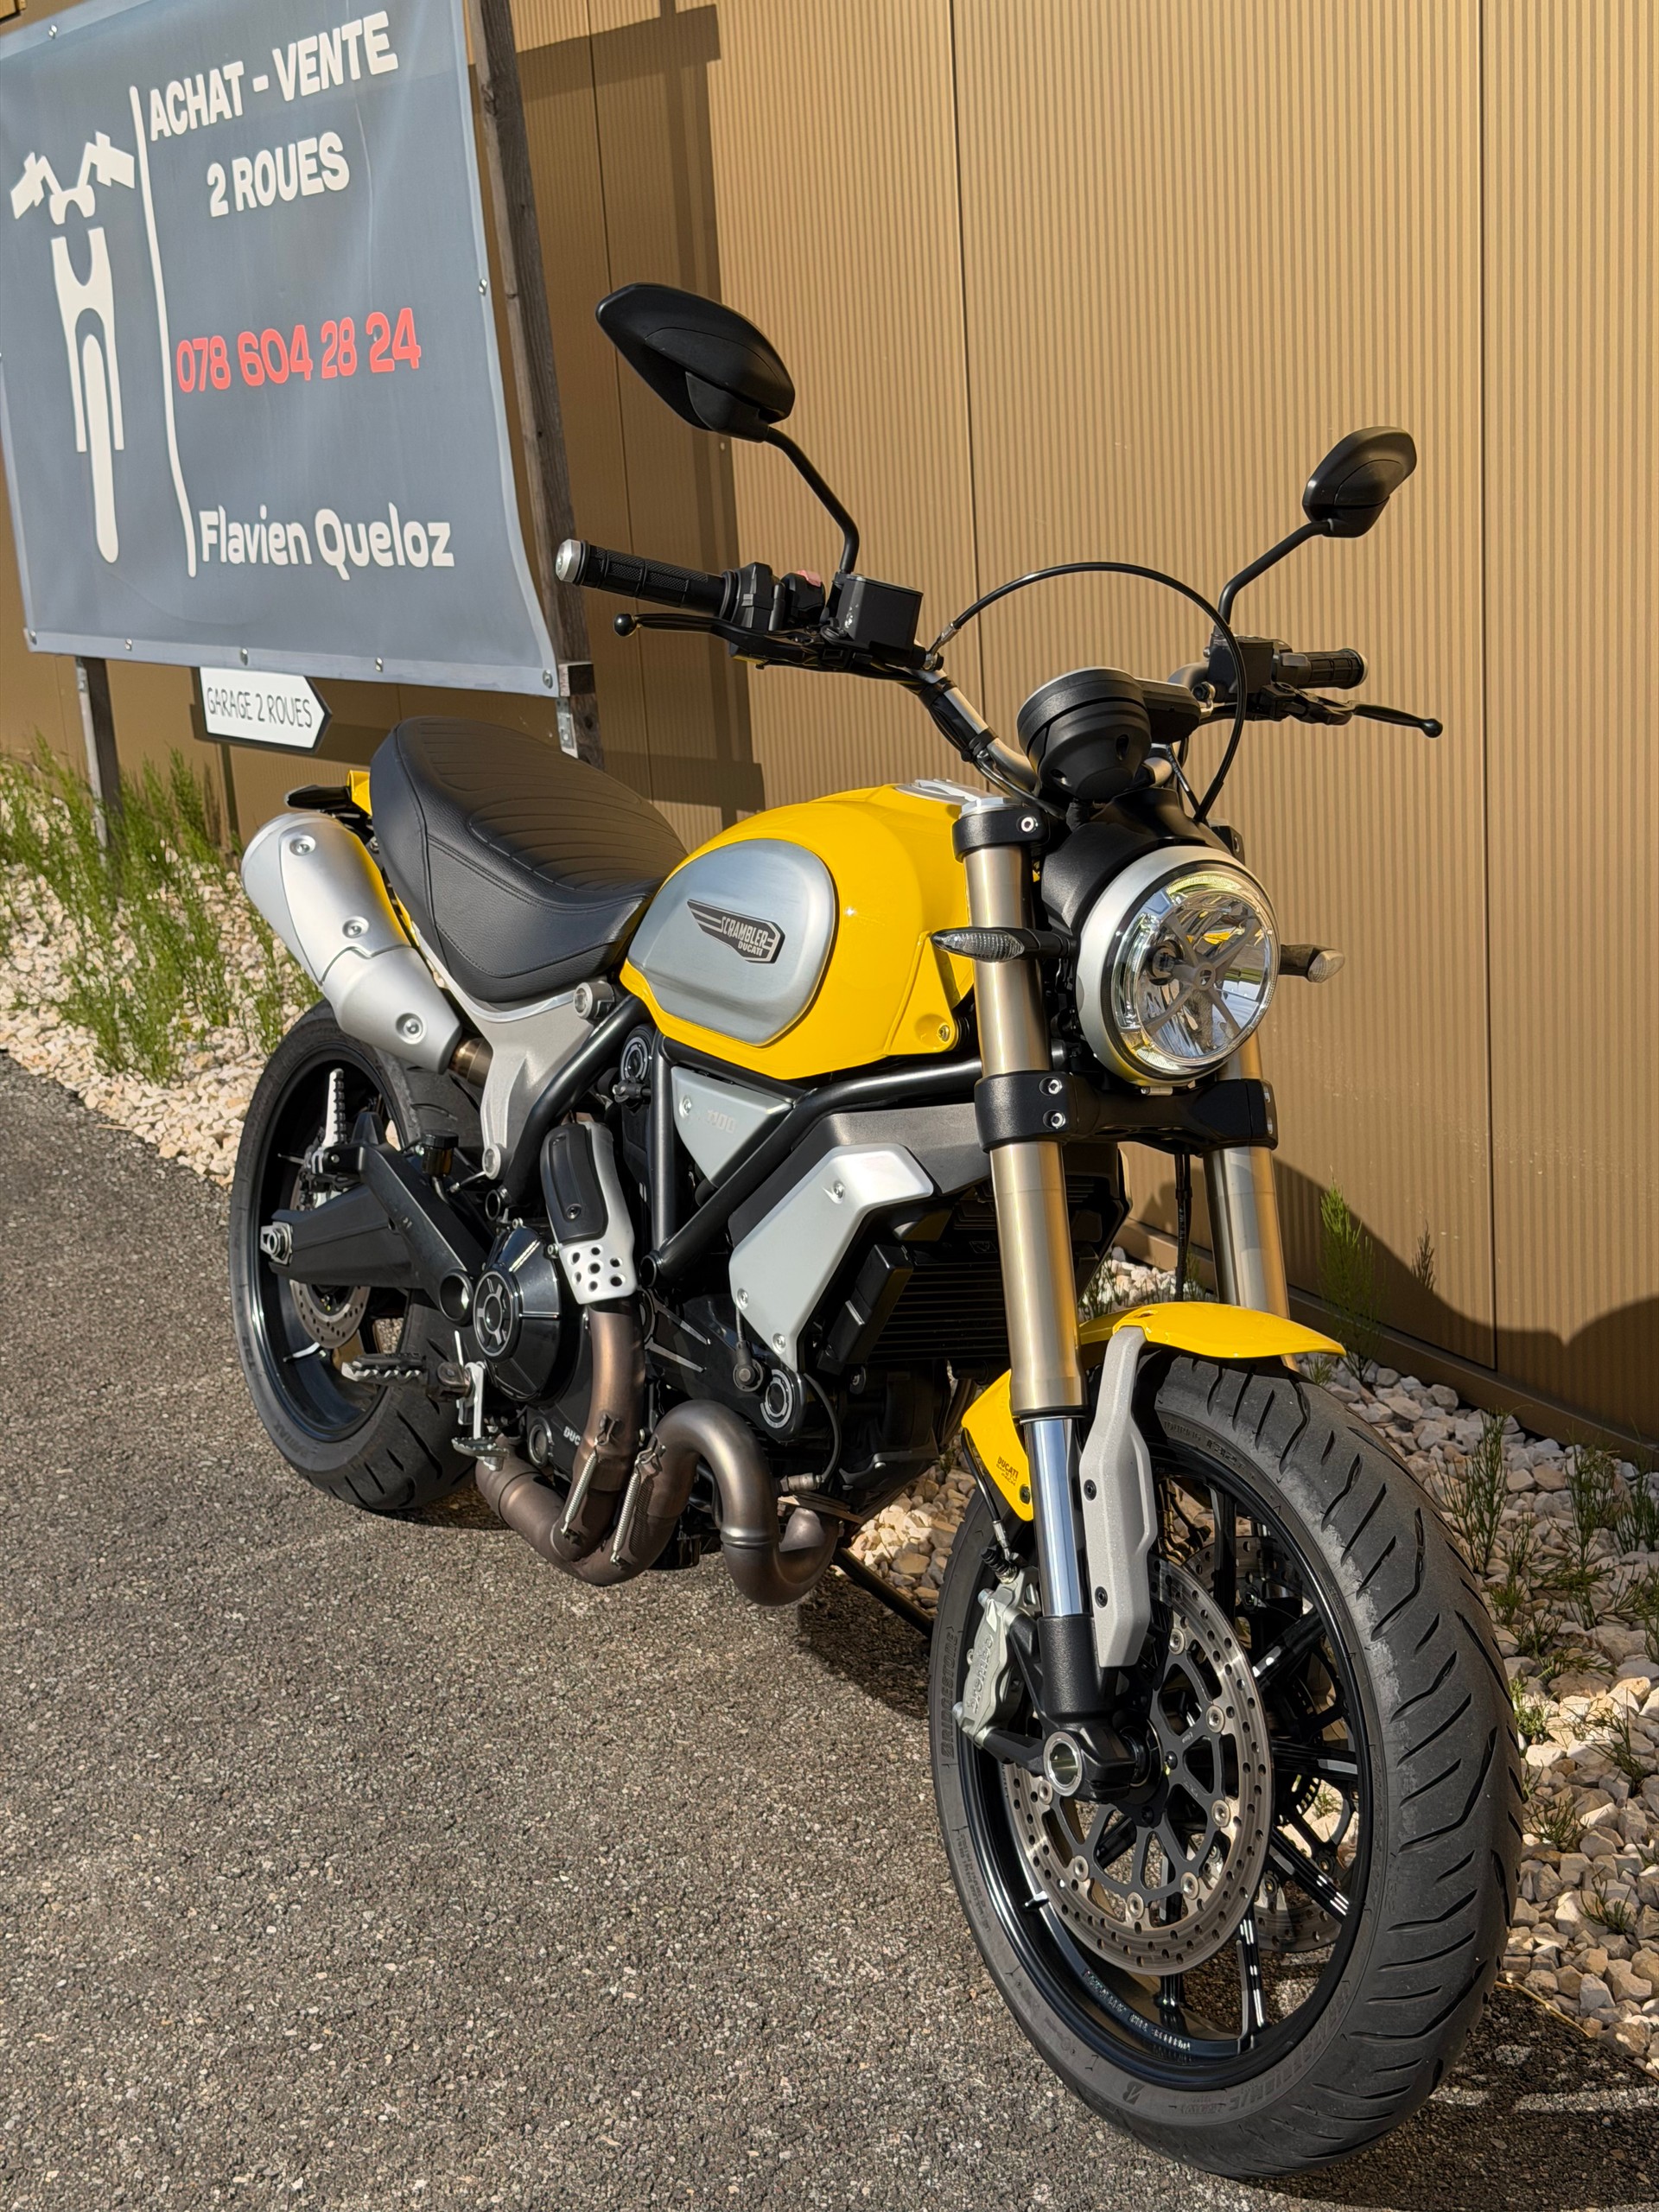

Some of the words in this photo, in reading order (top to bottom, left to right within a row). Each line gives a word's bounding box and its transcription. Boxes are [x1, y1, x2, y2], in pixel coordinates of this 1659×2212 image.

[149, 60, 245, 142] ACHAT
[271, 10, 399, 102] VENTE
[207, 162, 229, 218] 2
[232, 131, 350, 212] ROUES
[176, 336, 231, 392] 078
[238, 325, 313, 386] 604
[321, 317, 357, 378] 28
[365, 308, 421, 372] 24
[199, 505, 312, 565] Flavien
[315, 502, 454, 581] Queloz
[207, 687, 253, 721] GARAGE
[256, 693, 265, 722] 2
[267, 694, 313, 728] ROUES
[721, 916, 769, 948] SCRAMBLER
[738, 940, 764, 957] DUCATI
[563, 1426, 581, 1446] DUC
[997, 1456, 1019, 1479] DUCATI
[941, 1631, 958, 1759] BRIDGESTONE
[967, 1634, 995, 1714] brembo
